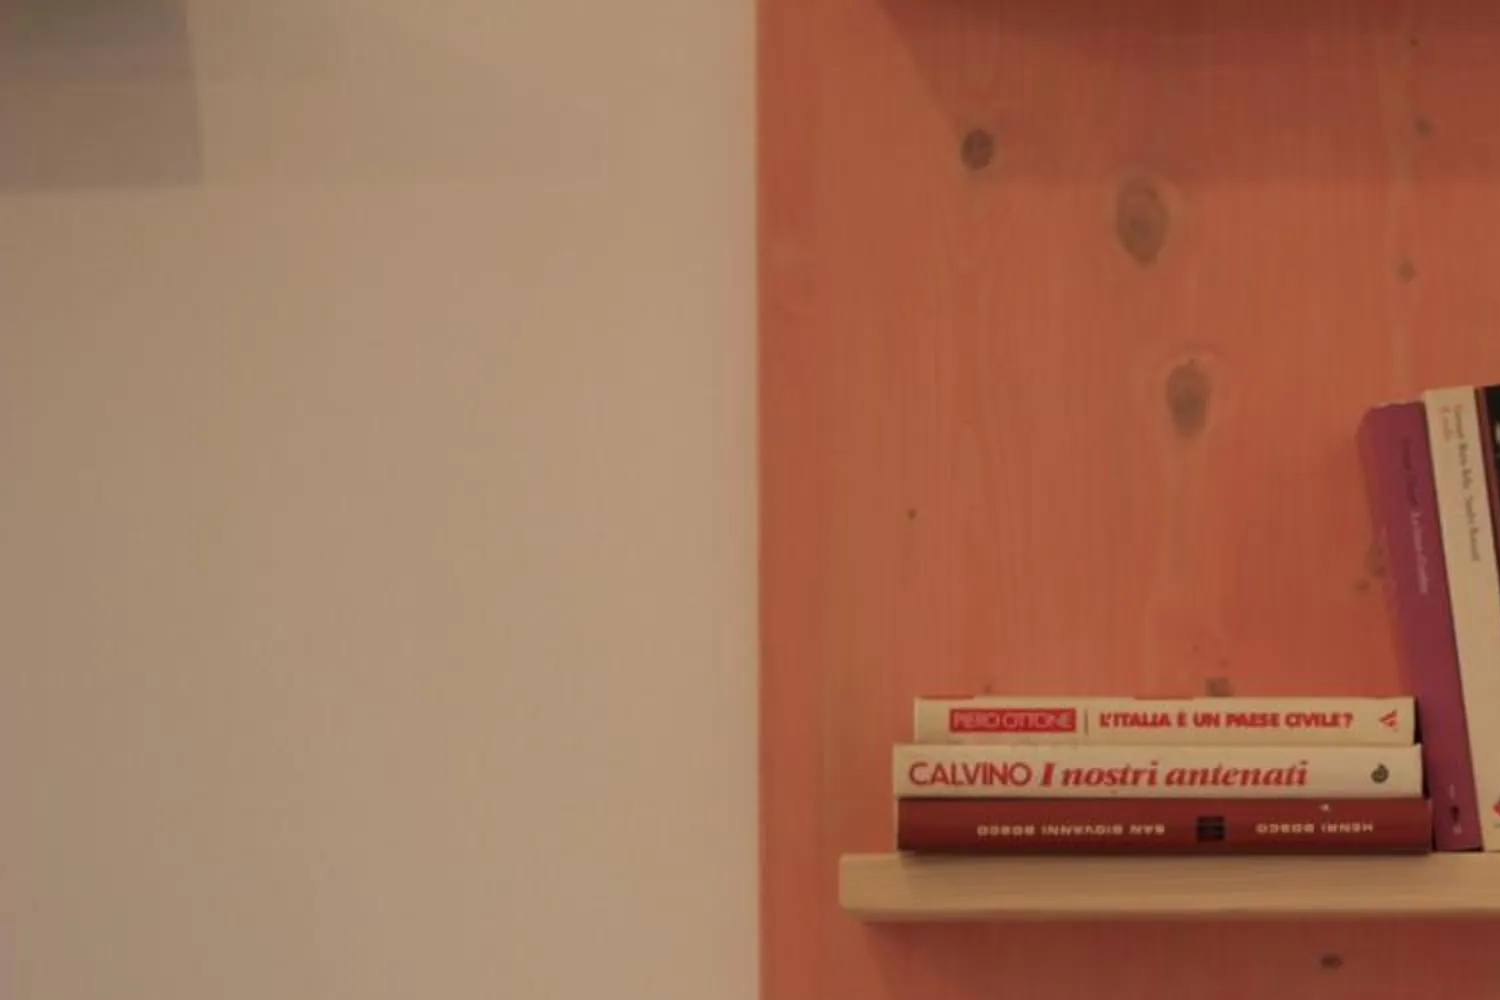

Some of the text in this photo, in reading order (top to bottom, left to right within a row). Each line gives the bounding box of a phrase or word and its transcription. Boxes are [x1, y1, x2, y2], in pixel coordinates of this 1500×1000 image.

[953, 711, 1074, 731] PIERO OTTONE
[1100, 712, 1170, 728] L'ITALIA
[1193, 712, 1219, 728] UN
[1226, 712, 1280, 728] PAESE
[1286, 712, 1353, 728] CIVILE?
[909, 762, 1032, 787] CALVINO
[1039, 760, 1309, 787] I nostri antenati
